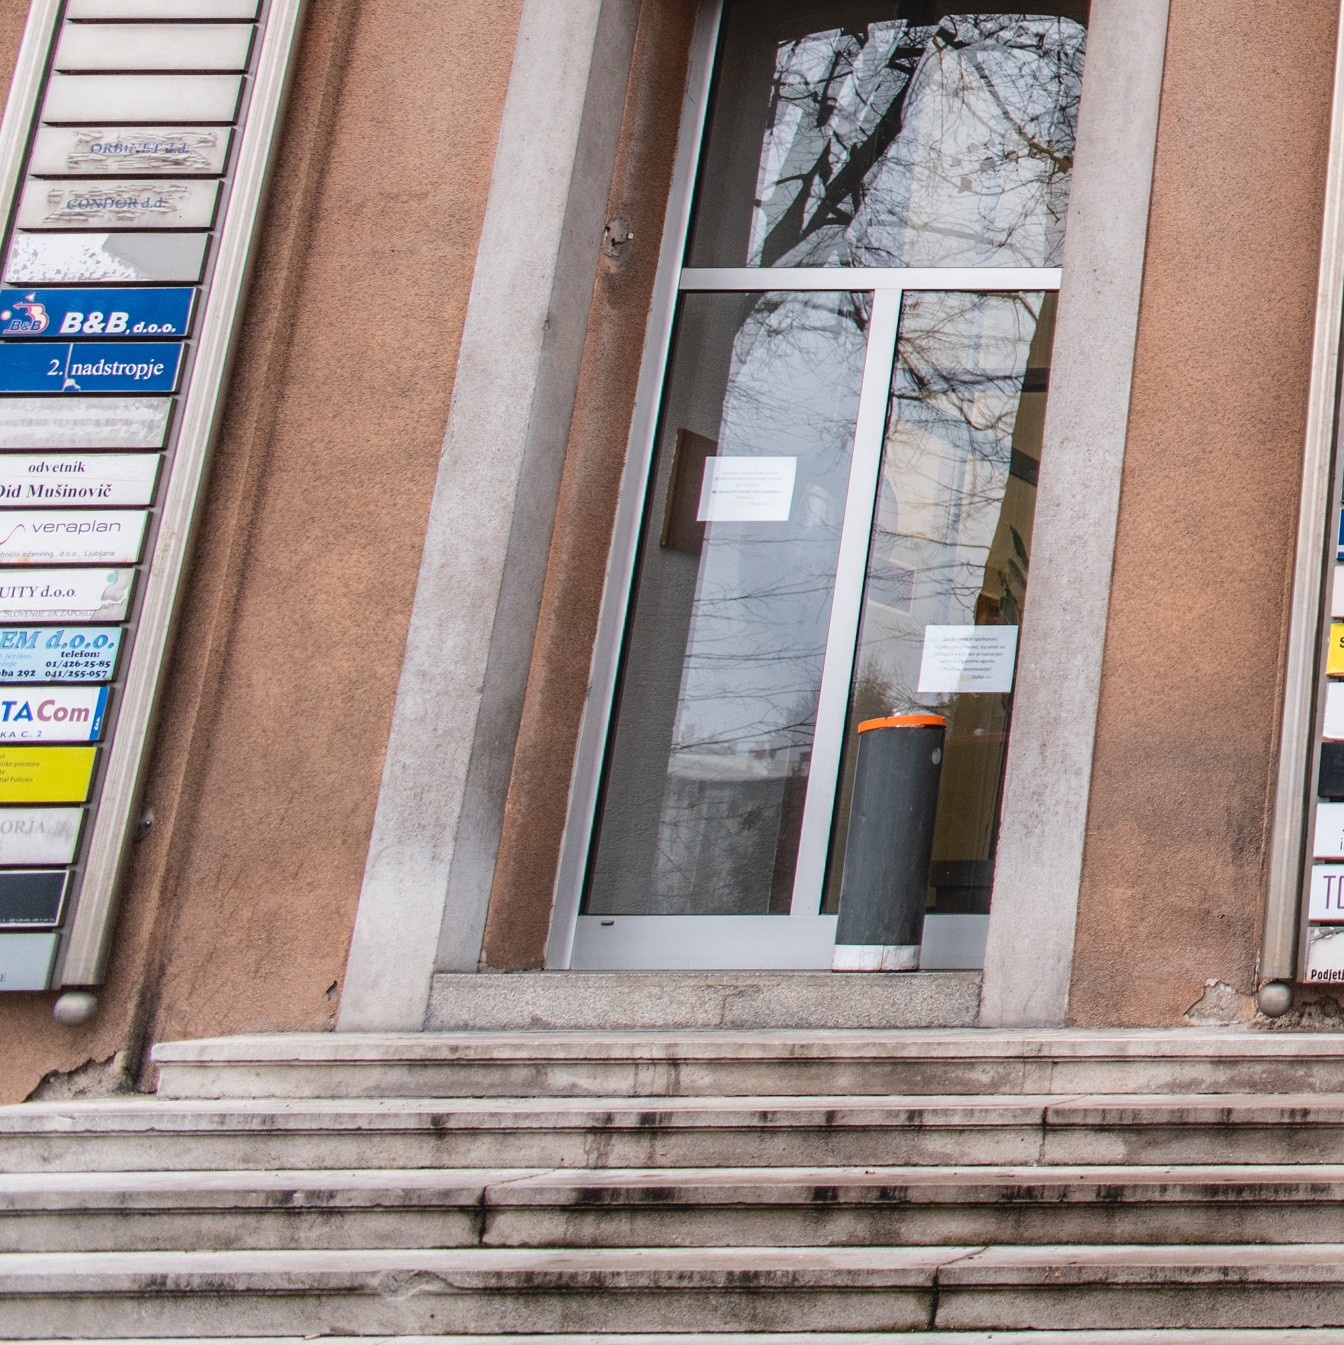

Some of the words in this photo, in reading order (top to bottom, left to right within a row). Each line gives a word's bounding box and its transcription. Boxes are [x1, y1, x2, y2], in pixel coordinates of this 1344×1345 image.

[133, 322, 176, 333] d.o.o.
[47, 359, 63, 375] 2.
[71, 359, 164, 380] nadstropje
[28, 462, 85, 473] odvetnik
[33, 520, 121, 535] veraplan
[46, 630, 114, 649] d.o.o.
